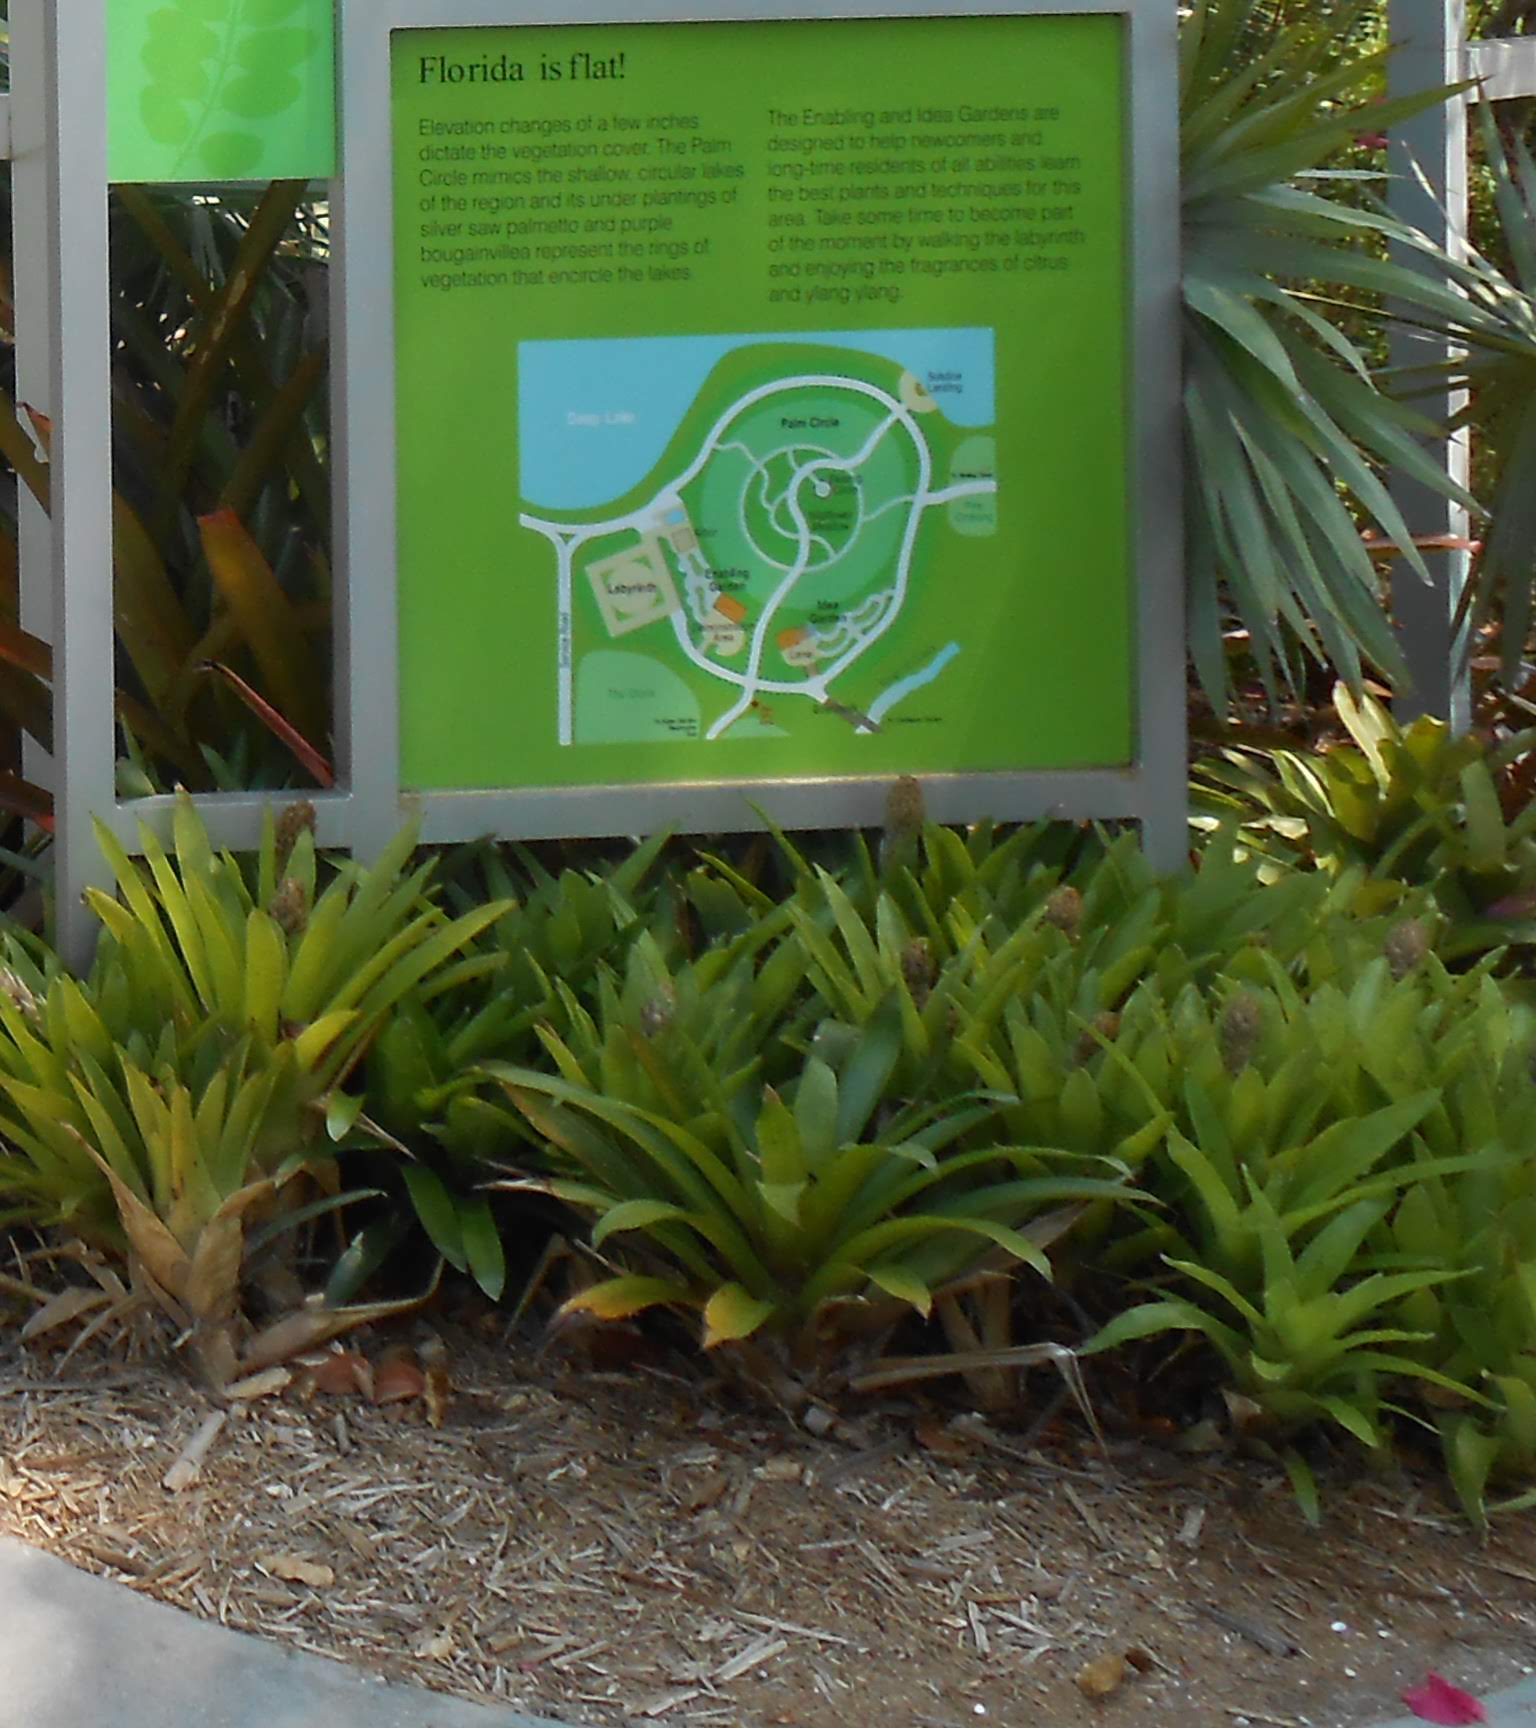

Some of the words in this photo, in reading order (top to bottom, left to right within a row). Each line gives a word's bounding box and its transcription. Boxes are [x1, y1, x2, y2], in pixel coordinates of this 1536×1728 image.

[419, 54, 524, 83] Florida
[541, 53, 562, 80] is
[570, 52, 625, 79] flat!
[419, 119, 493, 136] Elevation
[500, 119, 571, 137] changes
[576, 118, 592, 132] of
[597, 120, 608, 132] a
[614, 117, 640, 130] few
[646, 115, 699, 130] inches
[769, 110, 797, 126] The
[803, 109, 873, 128] Enabling
[880, 108, 912, 124] and
[918, 107, 953, 123] Idea
[959, 106, 1028, 121] Gardens
[1034, 107, 1059, 120] are
[419, 145, 475, 161] dictate
[481, 144, 506, 160] the
[513, 142, 598, 162] vegetation
[658, 138, 685, 155] The
[692, 137, 732, 154] Palm
[768, 135, 844, 155] designed
[849, 136, 864, 150] to
[870, 134, 905, 151] help
[912, 133, 1006, 148] newcomers
[1011, 130, 1042, 147] and
[419, 169, 467, 187] Circle
[473, 168, 531, 185] mimics
[538, 166, 562, 183] the
[638, 164, 696, 181] circular
[703, 163, 744, 180] lakes
[769, 161, 844, 180] long-time
[850, 159, 925, 175] residents
[931, 157, 946, 173] of
[952, 157, 971, 173] all
[975, 156, 1035, 172] abilities
[1041, 155, 1080, 169] learn
[420, 196, 436, 212] of
[442, 195, 467, 211] the
[473, 194, 525, 213] region
[530, 192, 562, 209] and
[567, 192, 585, 208] its
[590, 192, 637, 207] under
[643, 189, 717, 207] plantings
[722, 187, 737, 203] of
[769, 187, 793, 201] the
[799, 185, 834, 200] best
[840, 183, 889, 202] plants
[895, 183, 926, 199] and
[931, 179, 1021, 199] techniques
[1026, 179, 1048, 196] for
[1053, 179, 1081, 195] this
[420, 221, 463, 238] silver
[468, 222, 500, 236] saw
[507, 218, 579, 238] palmetto
[584, 217, 615, 234] and
[621, 215, 673, 235] purple
[817, 209, 852, 225] Take
[858, 211, 902, 224] some
[908, 208, 943, 223] time
[948, 208, 965, 223] to
[970, 206, 1035, 222] become
[1042, 205, 1073, 222] part
[421, 244, 530, 265] bougainvillea
[536, 242, 613, 262] represent
[618, 241, 643, 257] the
[649, 240, 688, 258] rings
[693, 238, 710, 255] of
[769, 236, 785, 252] of
[790, 235, 814, 251] the
[821, 234, 887, 250] moment
[893, 232, 912, 252] by
[918, 231, 980, 250] walking
[985, 229, 1010, 246] the
[1015, 228, 1084, 247] labyrinth
[421, 269, 508, 291] vegetation
[513, 270, 544, 286] that
[549, 268, 613, 285] encircle
[618, 266, 643, 282] the
[769, 260, 800, 277] and
[805, 259, 874, 279] enjoying
[880, 257, 904, 274] the
[911, 255, 998, 277] fragrances
[1003, 254, 1019, 271] of
[1024, 254, 1068, 269] citrus
[769, 285, 800, 302] and
[780, 416, 811, 430] Palm
[814, 415, 840, 428] Circle
[607, 582, 657, 596] Labyrinth
